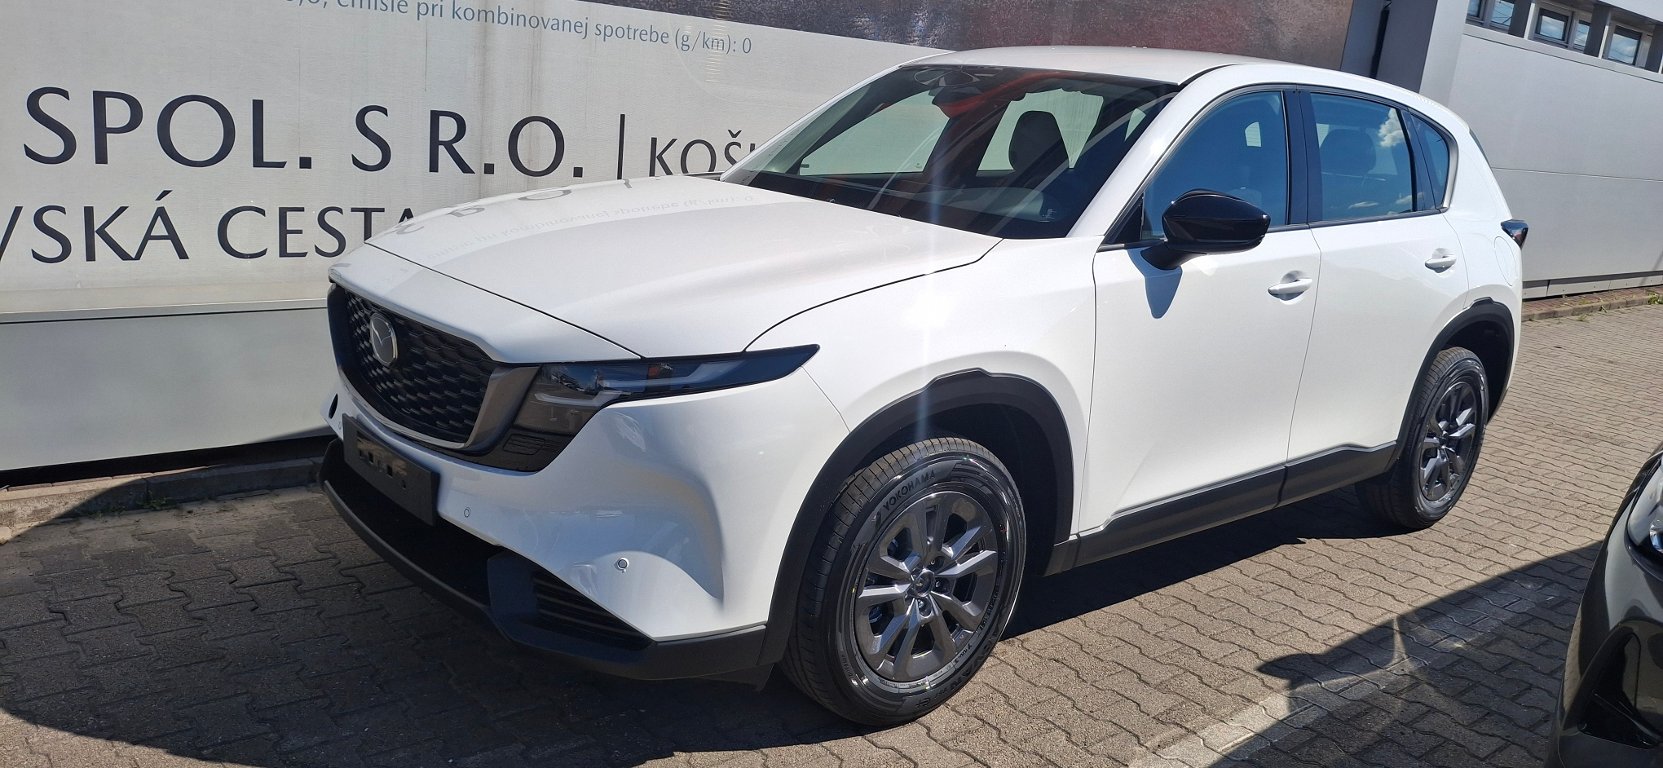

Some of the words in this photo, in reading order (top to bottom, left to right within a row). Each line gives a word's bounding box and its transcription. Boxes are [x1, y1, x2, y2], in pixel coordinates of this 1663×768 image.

[416, 0, 444, 21] pri
[452, 0, 589, 40] kombinovanej
[594, 24, 670, 45] spotrebe
[675, 28, 737, 55] (g/km):
[23, 86, 312, 170] SPOL.
[351, 104, 392, 172] S
[649, 129, 756, 177] KOŠ
[882, 469, 936, 511] YOKOHAMA
